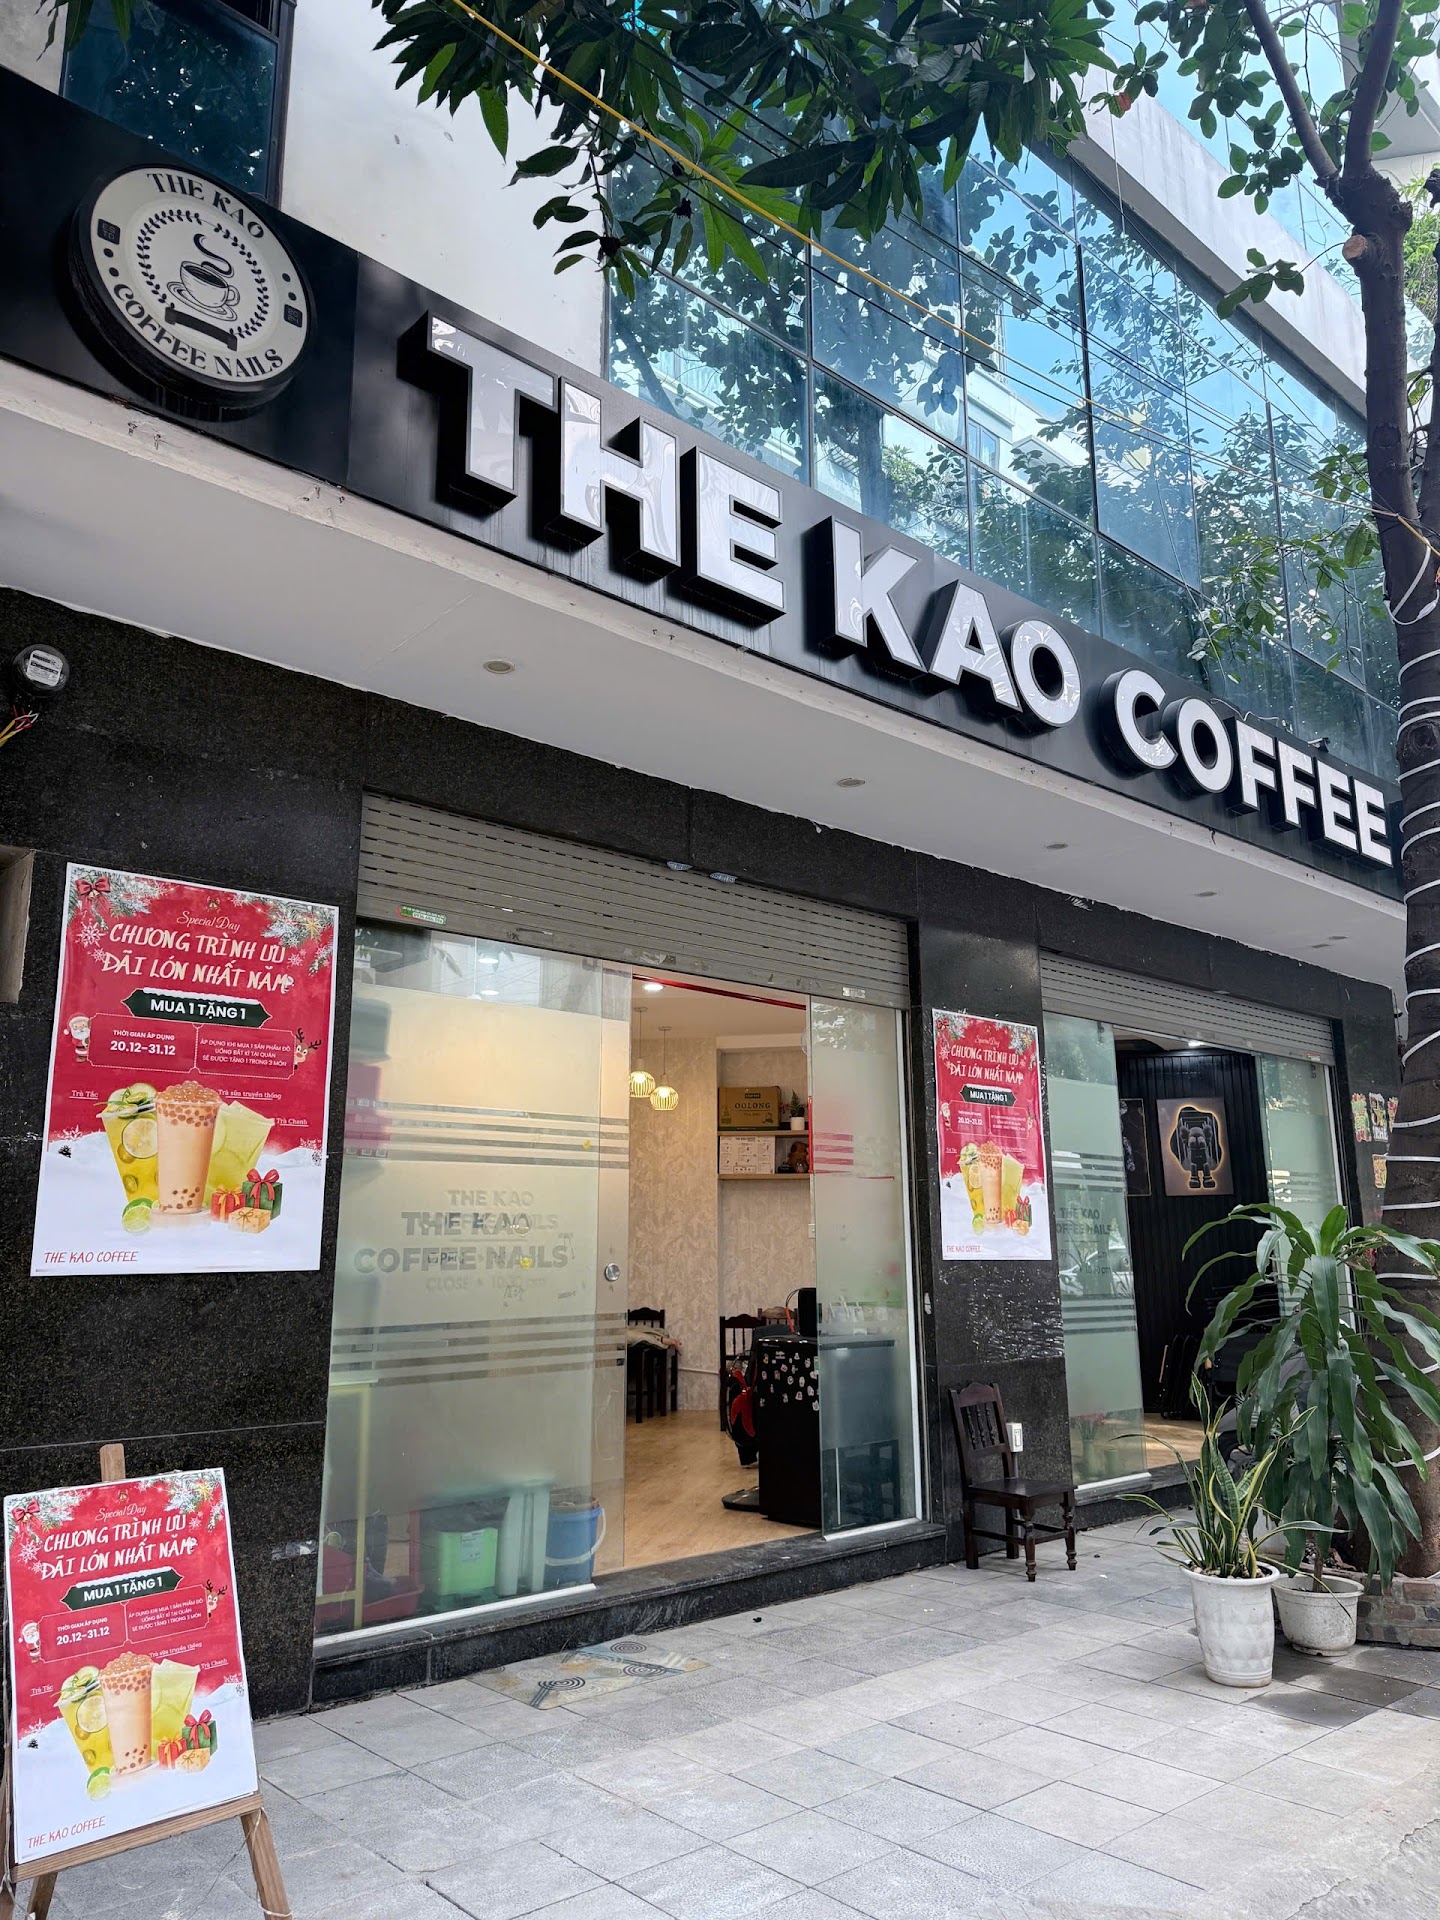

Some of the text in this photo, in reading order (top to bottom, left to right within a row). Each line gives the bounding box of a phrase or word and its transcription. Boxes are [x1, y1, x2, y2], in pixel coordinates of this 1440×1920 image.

[147, 173, 264, 238] THE KAO
[114, 284, 283, 377] COFFEE NAILS
[429, 310, 1393, 868] THE KAO COFFEE
[177, 911, 240, 934] Special Day
[196, 933, 255, 959] TRÌNH
[260, 943, 286, 963] ƯU
[102, 950, 147, 975] ĐÃI
[192, 959, 245, 987] NHẤT
[247, 966, 289, 994] NĂM
[151, 1000, 245, 1019] MUA 1 TẶNG 1
[147, 1031, 155, 1039] ÁP
[156, 1033, 175, 1041] DỤNG
[950, 1061, 966, 1076] ĐÃI
[983, 1048, 1008, 1064] TRÌNH
[970, 1091, 984, 1099] MUA
[988, 1091, 1004, 1102] TẶNG
[401, 1211, 462, 1236] THE
[471, 1212, 531, 1235] KAO
[1060, 1208, 1099, 1219] THE KAO
[45, 1251, 138, 1263] THE KAO COFFEE
[353, 1246, 477, 1273] COFFEE
[486, 1245, 568, 1270] NAILS
[95, 1503, 147, 1521] Special Day
[112, 1517, 162, 1541] TRÌNH
[166, 1514, 187, 1532] ƯU
[41, 1555, 75, 1580] ĐÃI
[114, 1538, 156, 1566] NHẤT
[159, 1534, 195, 1558] NĂM
[83, 1577, 162, 1602] MUA 1 TẶNG 1
[93, 1617, 108, 1626] DỤNG
[28, 1816, 105, 1848] THE KAO COFFEE
